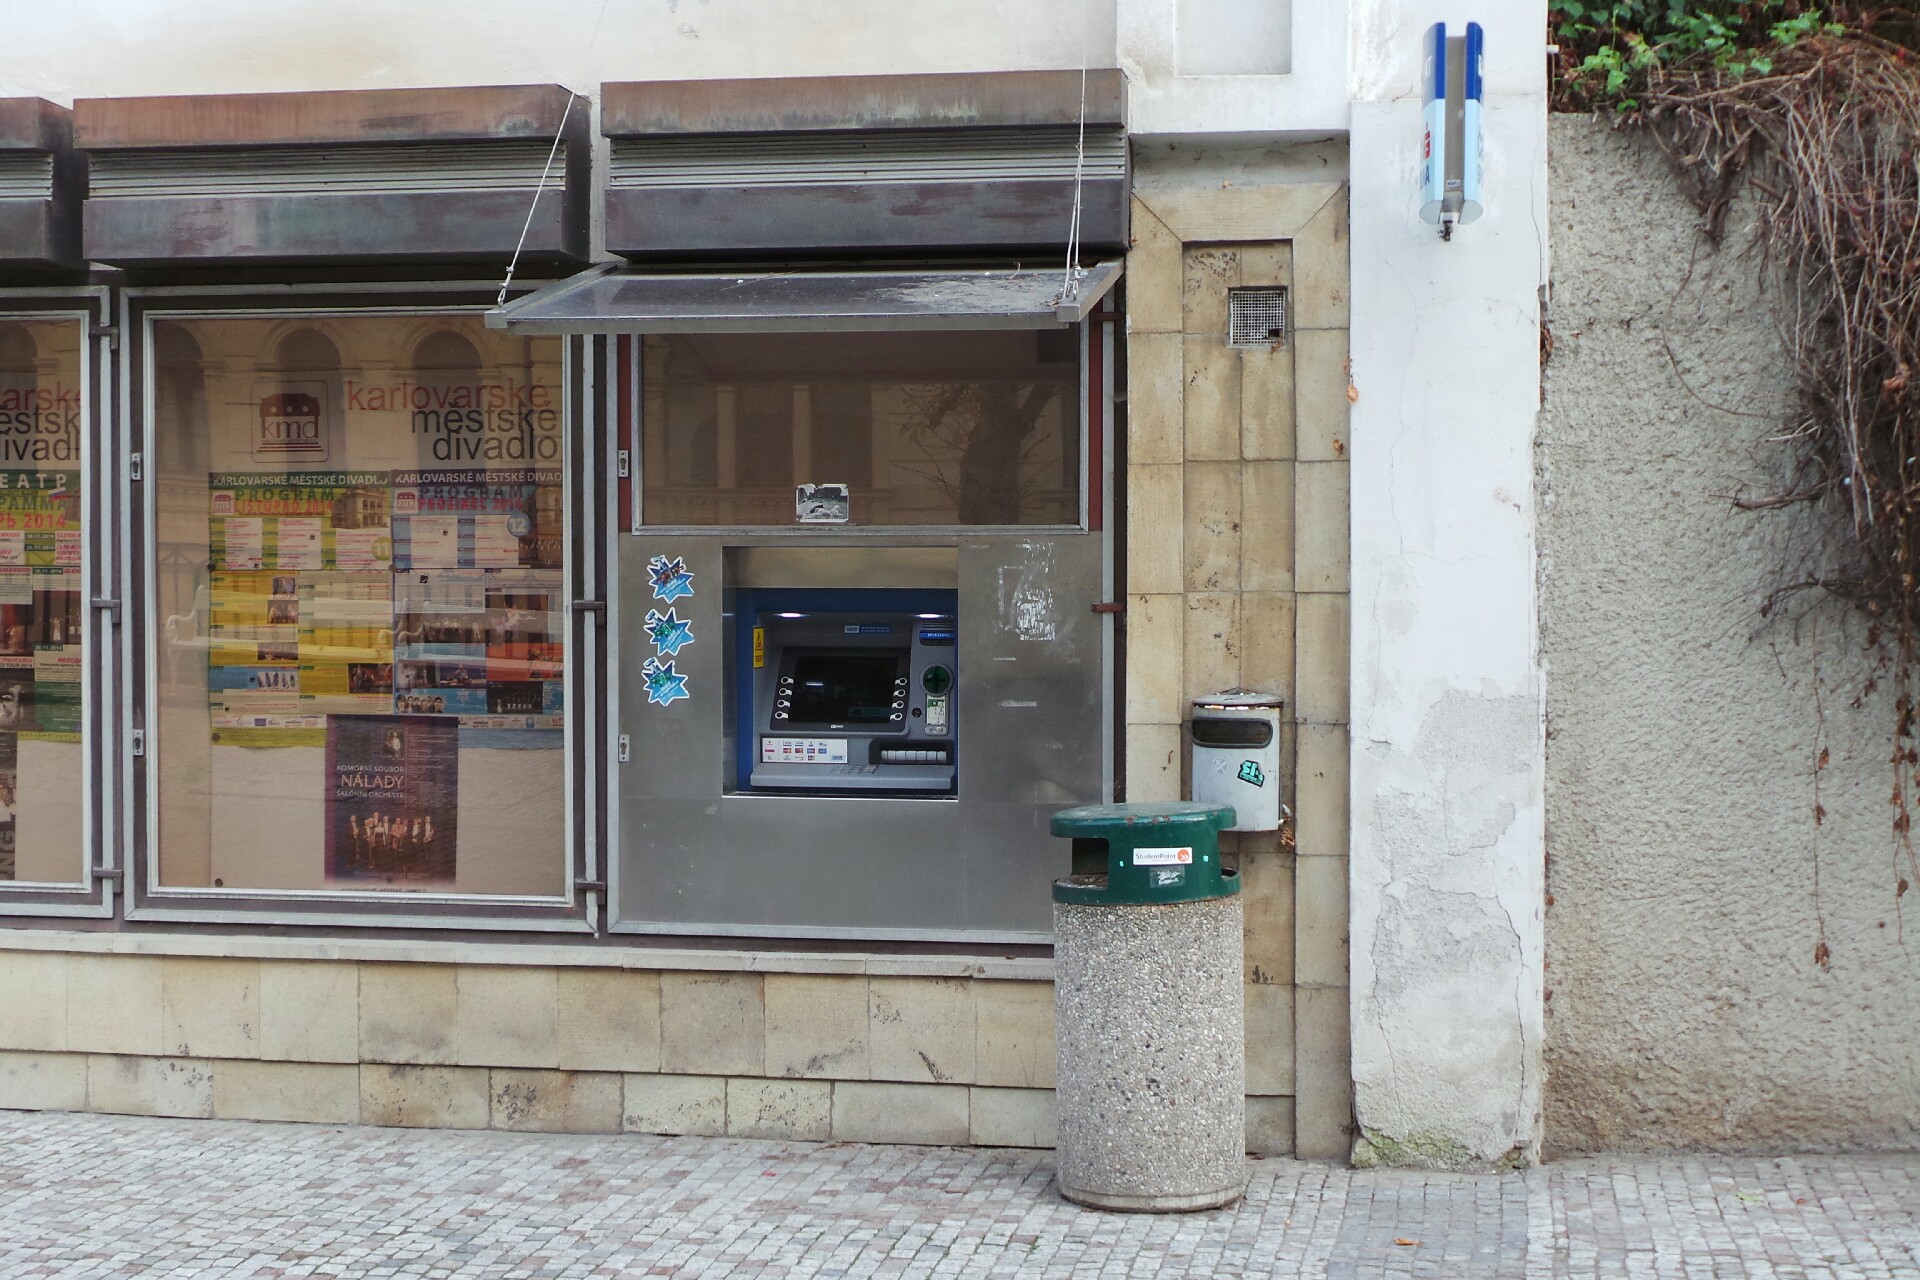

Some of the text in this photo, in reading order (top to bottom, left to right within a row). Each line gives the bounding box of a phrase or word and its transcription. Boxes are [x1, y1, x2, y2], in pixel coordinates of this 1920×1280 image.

[347, 376, 551, 410] karlovarské
[411, 401, 557, 434] městské
[261, 416, 319, 439] kmd
[432, 430, 558, 461] divadlo
[213, 475, 287, 486] KARLOVARSKÉ
[290, 474, 336, 485] MĚSTSKÉ
[395, 471, 474, 483] KARLOVARSKÉ
[475, 471, 525, 482] MĚSTSKÉ
[235, 489, 334, 501] PROGRAM
[420, 486, 523, 499] PROGRAM
[23, 513, 66, 528] 2014
[510, 517, 527, 532] 12
[341, 771, 405, 788] NÁLADY
